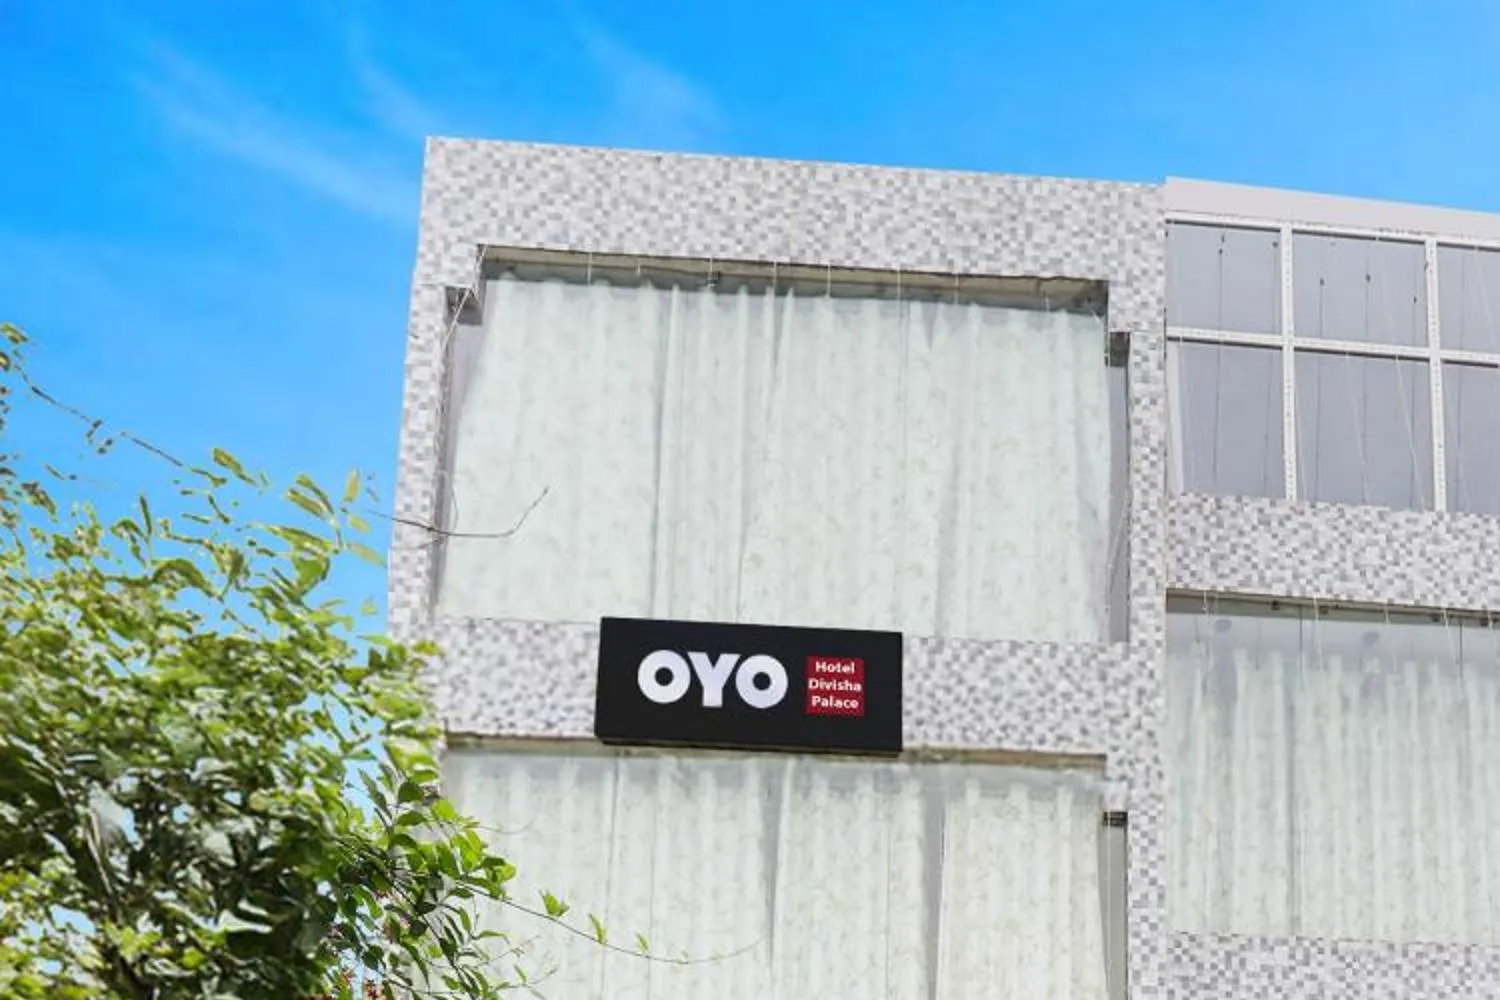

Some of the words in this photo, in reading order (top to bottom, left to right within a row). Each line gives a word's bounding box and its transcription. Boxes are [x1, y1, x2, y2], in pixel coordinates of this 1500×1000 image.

[815, 661, 855, 673] Hotel
[637, 649, 789, 709] OYO
[808, 678, 862, 691] Divisha
[811, 695, 859, 708] Palace
